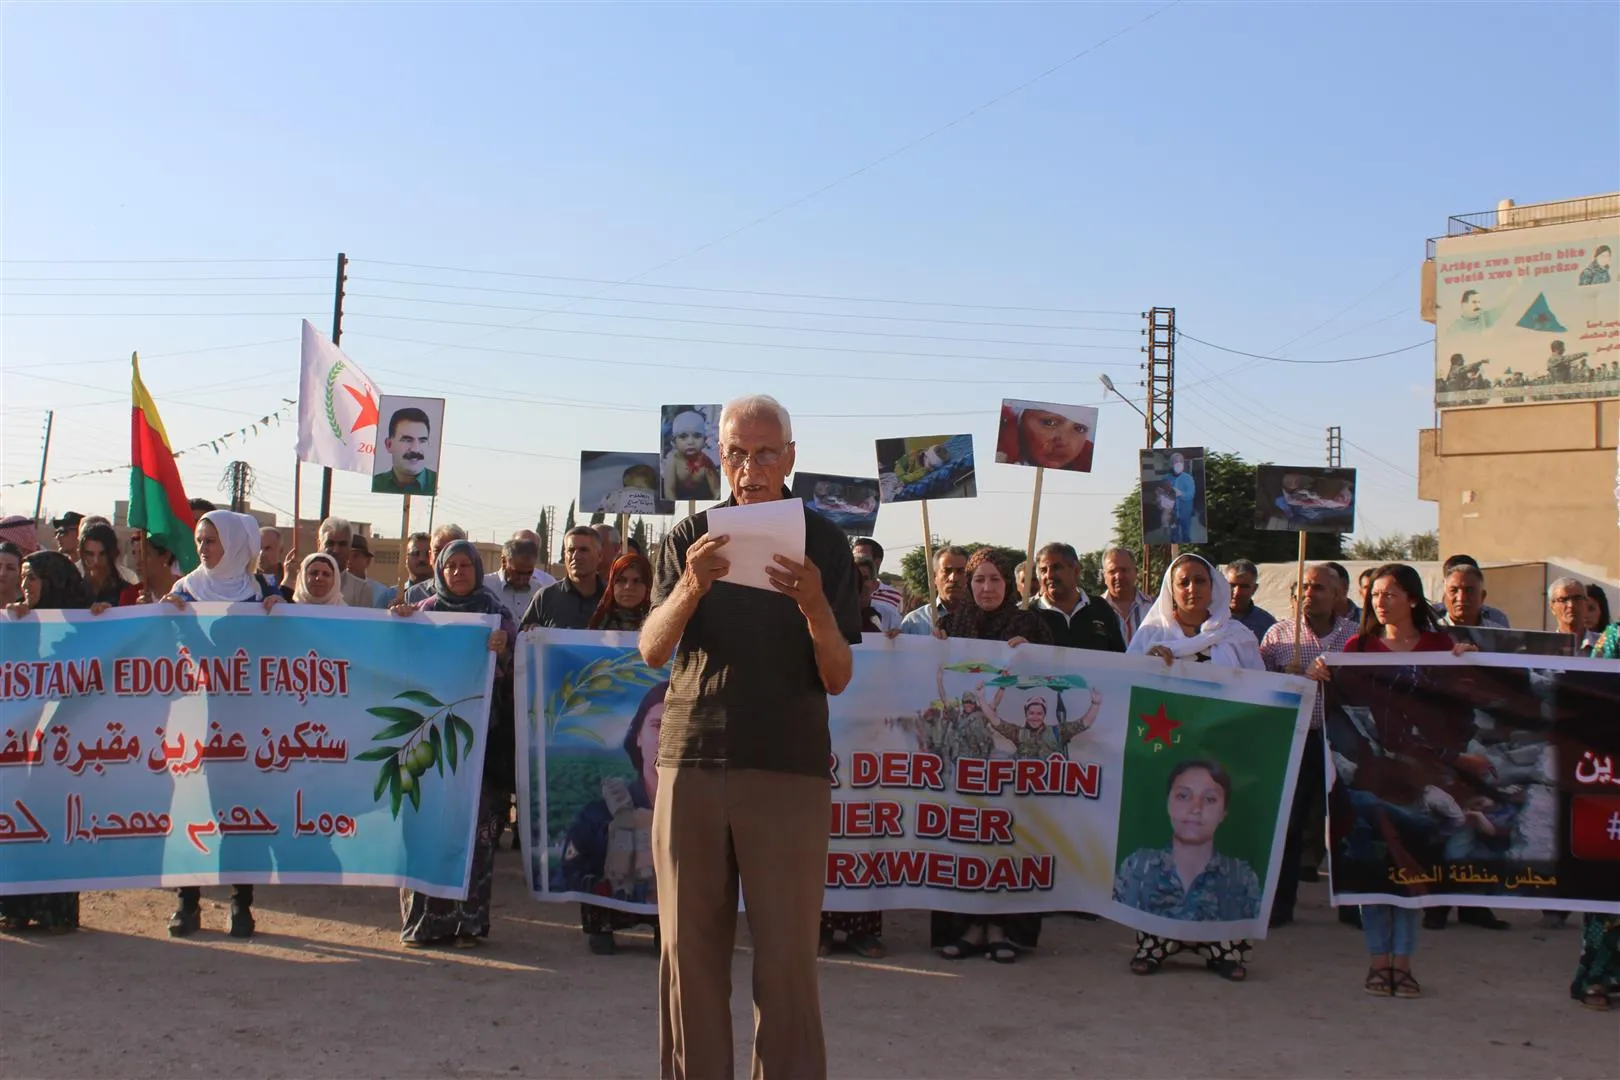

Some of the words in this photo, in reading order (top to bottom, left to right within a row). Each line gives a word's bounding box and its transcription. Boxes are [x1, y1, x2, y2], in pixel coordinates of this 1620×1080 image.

[0, 657, 104, 698] iSTANA
[259, 648, 349, 703] FAŞÎST
[50, 721, 142, 775] مقبرة
[148, 721, 247, 775] عفرين
[254, 721, 348, 771] ستكون
[851, 752, 944, 789] DER
[955, 753, 1100, 797] EFRÎN
[915, 802, 1013, 844] DER
[1388, 864, 1442, 885] الحسكة
[1450, 864, 1499, 883] منطقة
[1504, 866, 1557, 889] مجلس
